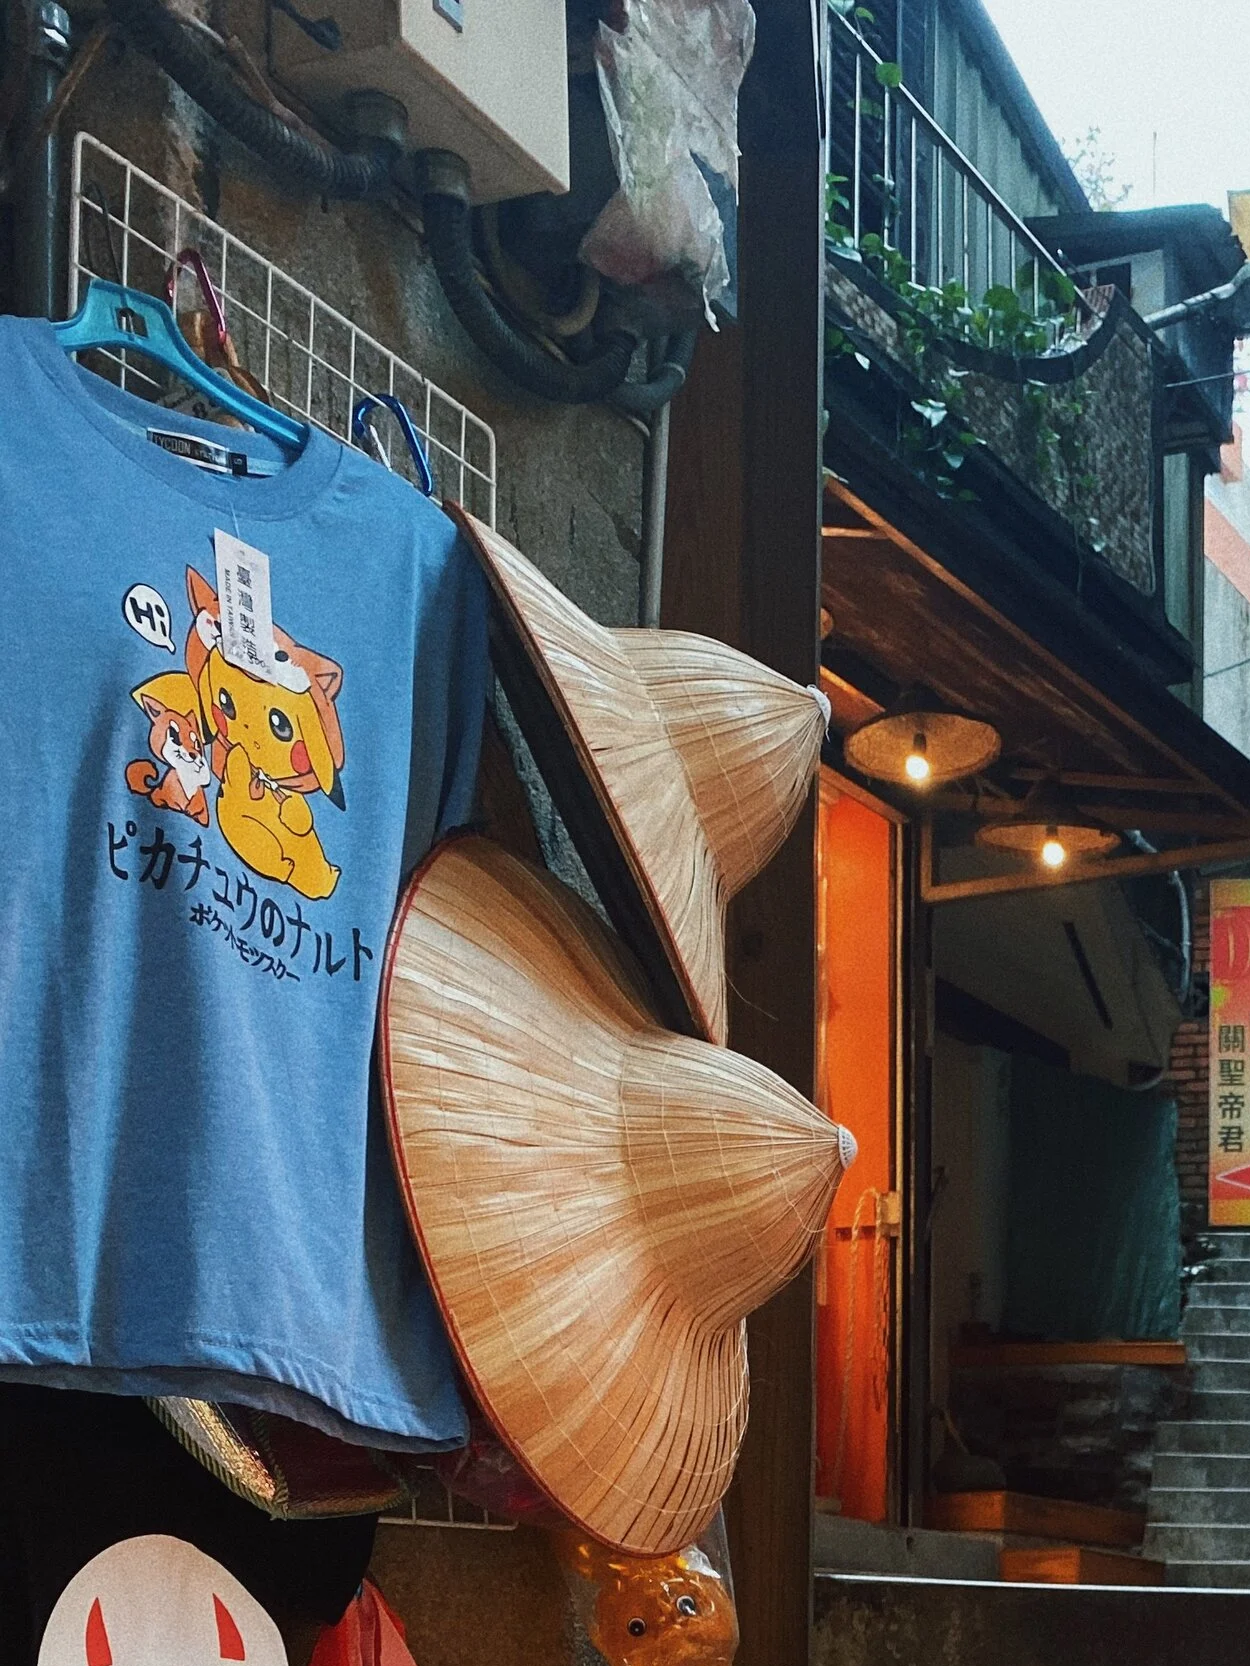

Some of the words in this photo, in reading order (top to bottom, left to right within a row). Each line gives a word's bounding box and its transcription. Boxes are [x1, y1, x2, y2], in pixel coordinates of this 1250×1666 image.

[224, 568, 232, 595] MADE
[129, 596, 167, 637] Hi
[1217, 1024, 1246, 1154] 關聖帝君
